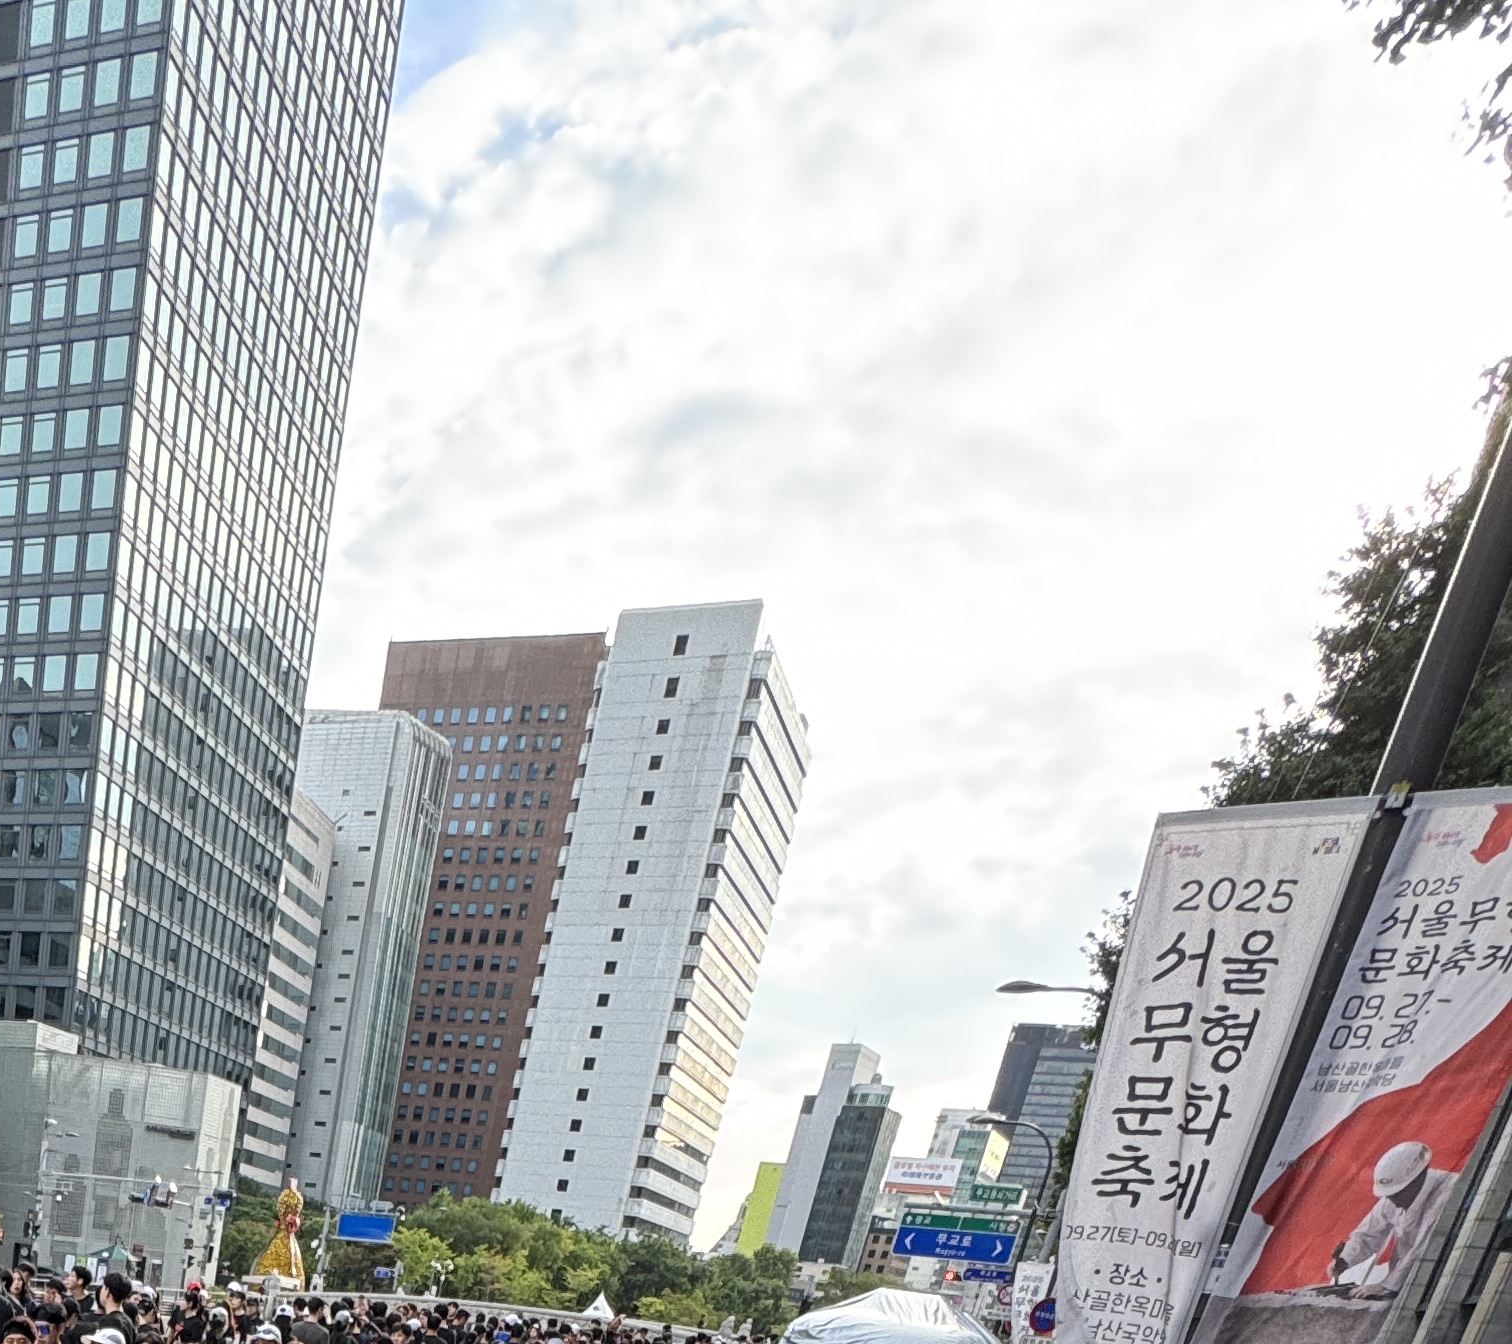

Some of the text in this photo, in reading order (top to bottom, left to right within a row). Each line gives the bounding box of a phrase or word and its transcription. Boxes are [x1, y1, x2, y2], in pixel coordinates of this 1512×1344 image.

[1173, 877, 1299, 914] 2025
[1394, 875, 1464, 899] 2025
[1377, 897, 1512, 940] 서울무
[1151, 928, 1279, 995] 서울
[1129, 1002, 1261, 1073] 무형
[1112, 1075, 1232, 1146] 문화
[1091, 1145, 1210, 1220] 축제
[935, 1233, 973, 1247] 무교로
[988, 1222, 1007, 1233] 시청
[1018, 1284, 1040, 1297] 서울
[1109, 1263, 1149, 1289] 장소
